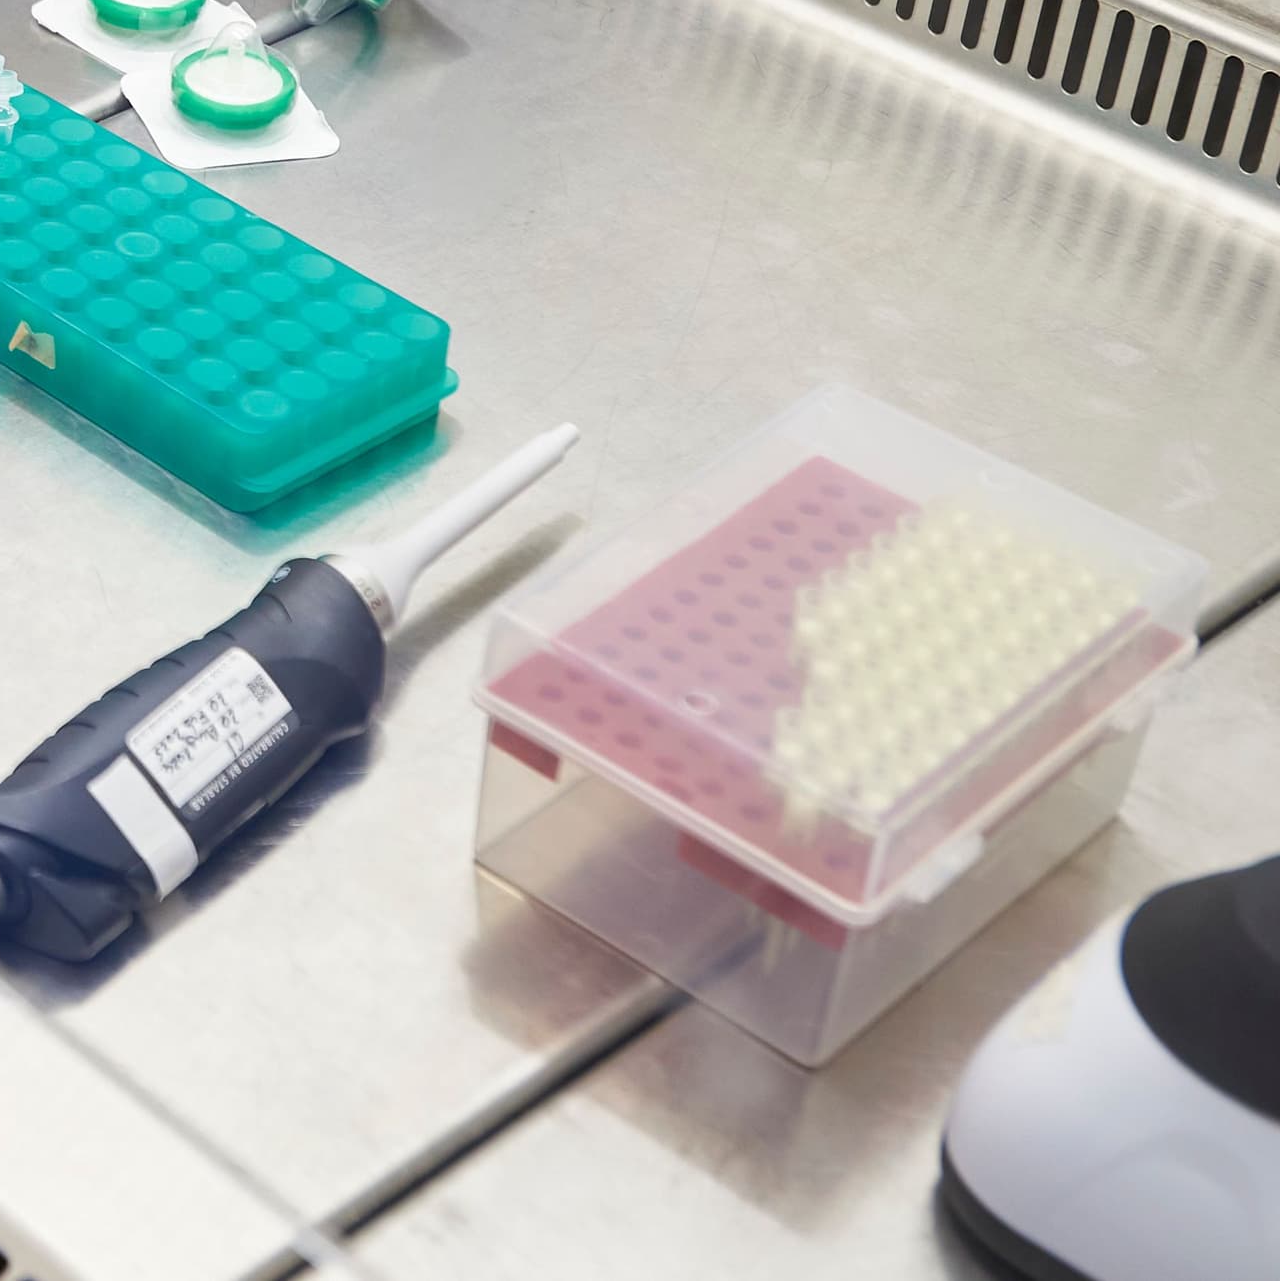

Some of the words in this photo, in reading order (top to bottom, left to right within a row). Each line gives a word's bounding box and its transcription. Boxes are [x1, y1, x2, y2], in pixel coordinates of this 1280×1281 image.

[239, 721, 289, 768] CALIBRATED
[228, 762, 243, 780] BY
[189, 774, 230, 811] STARLAB
